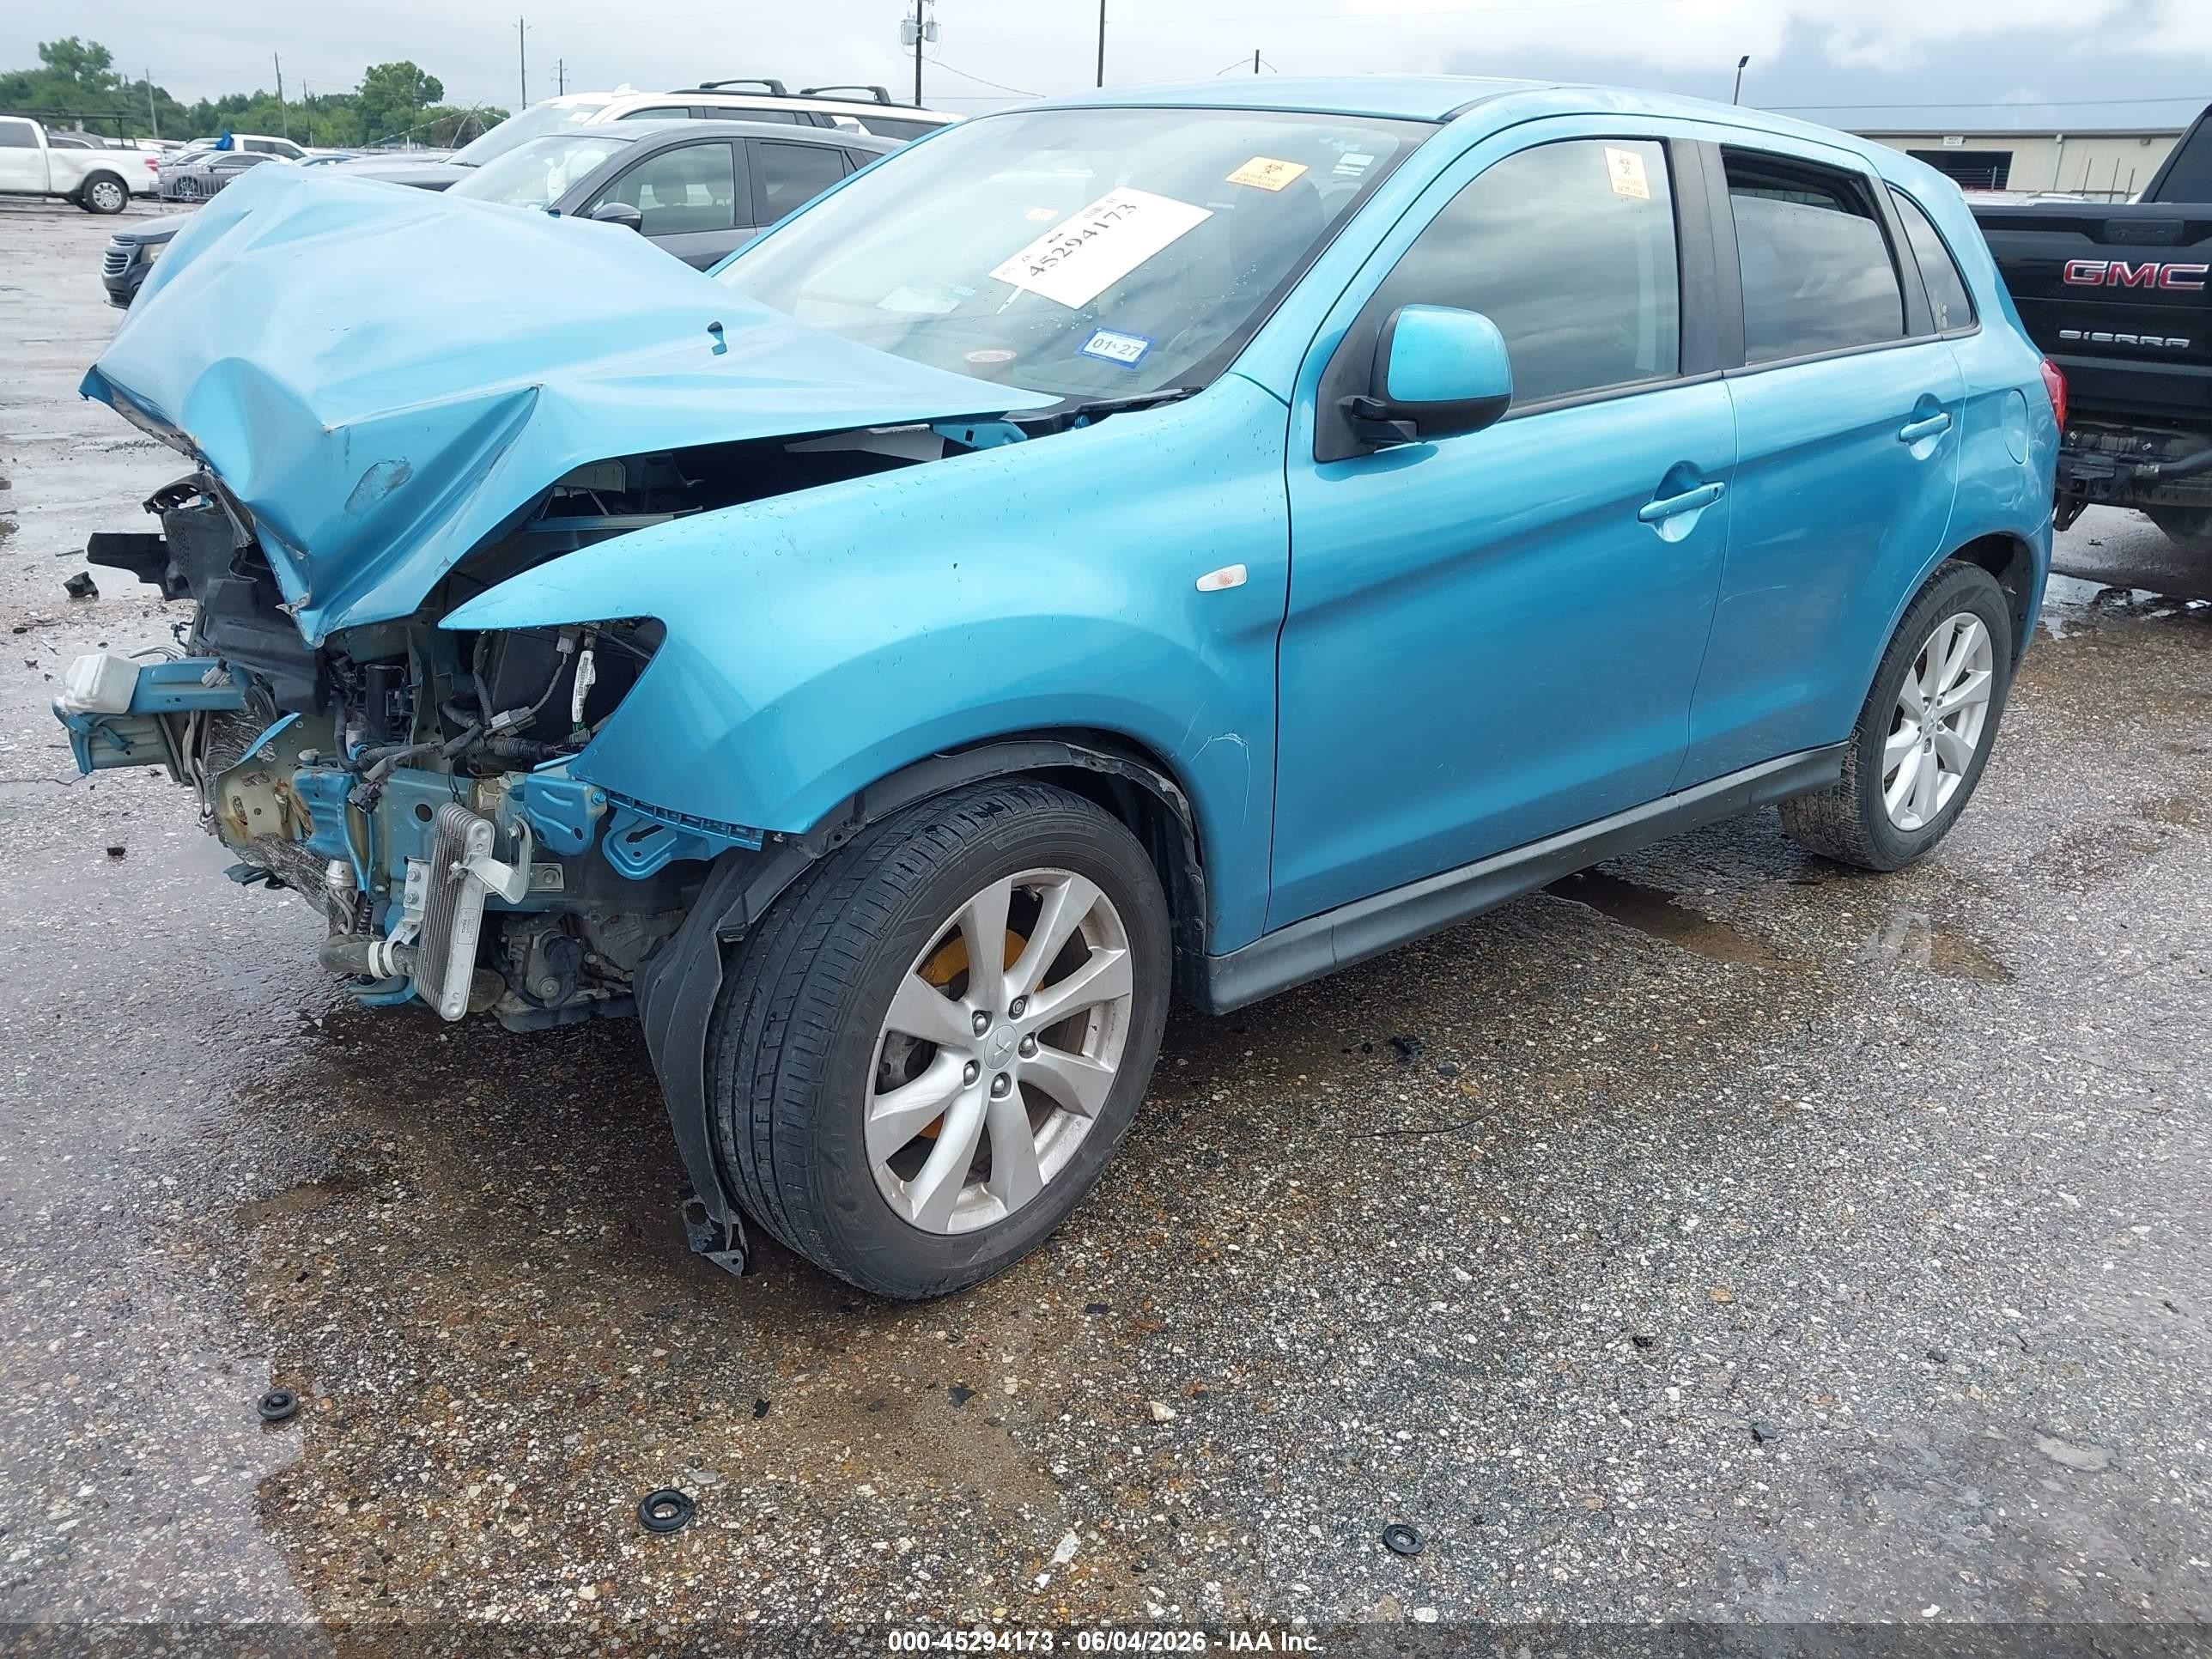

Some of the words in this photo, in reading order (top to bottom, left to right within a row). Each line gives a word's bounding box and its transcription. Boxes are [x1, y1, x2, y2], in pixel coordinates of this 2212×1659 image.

[1030, 204, 1137, 276] 45294173
[2063, 258, 2209, 290] GMC
[2058, 329, 2191, 349] SIERRA
